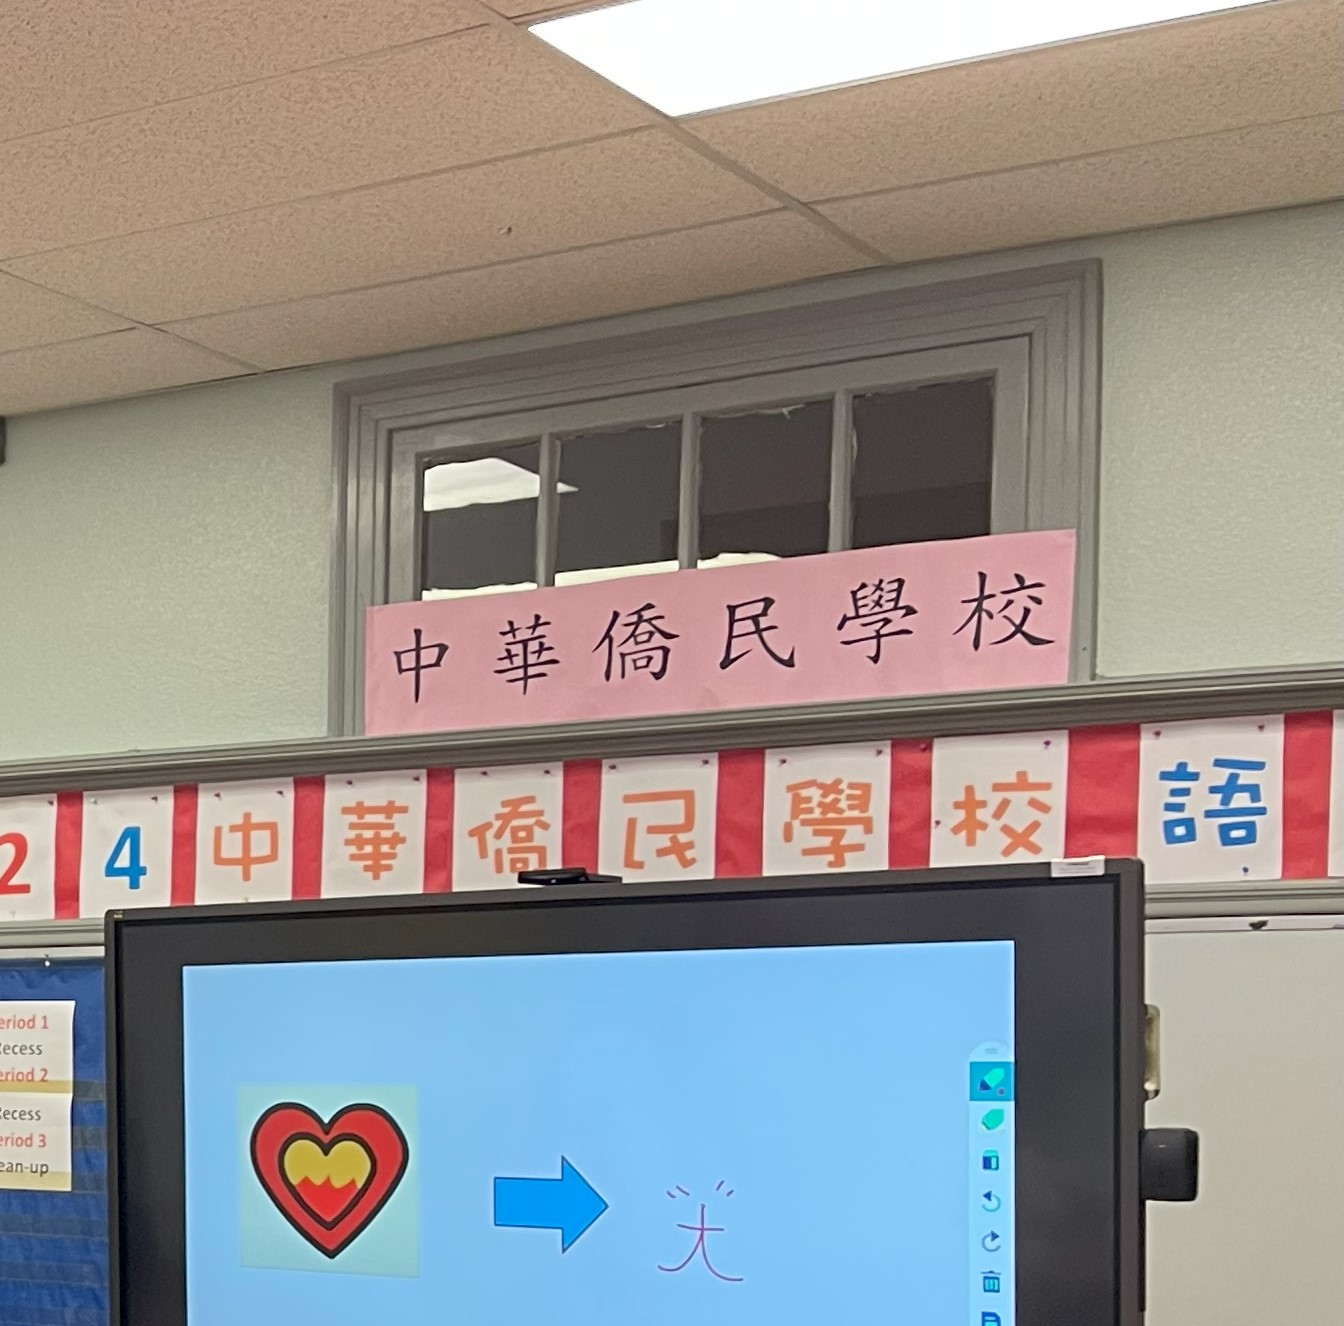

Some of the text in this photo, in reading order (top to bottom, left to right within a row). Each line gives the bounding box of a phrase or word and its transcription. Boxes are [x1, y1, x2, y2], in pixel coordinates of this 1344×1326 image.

[392, 570, 1056, 704] 中華僑民學校
[41, 1015, 48, 1029] 1
[39, 1067, 48, 1083] 2
[38, 1133, 47, 1148] 3
